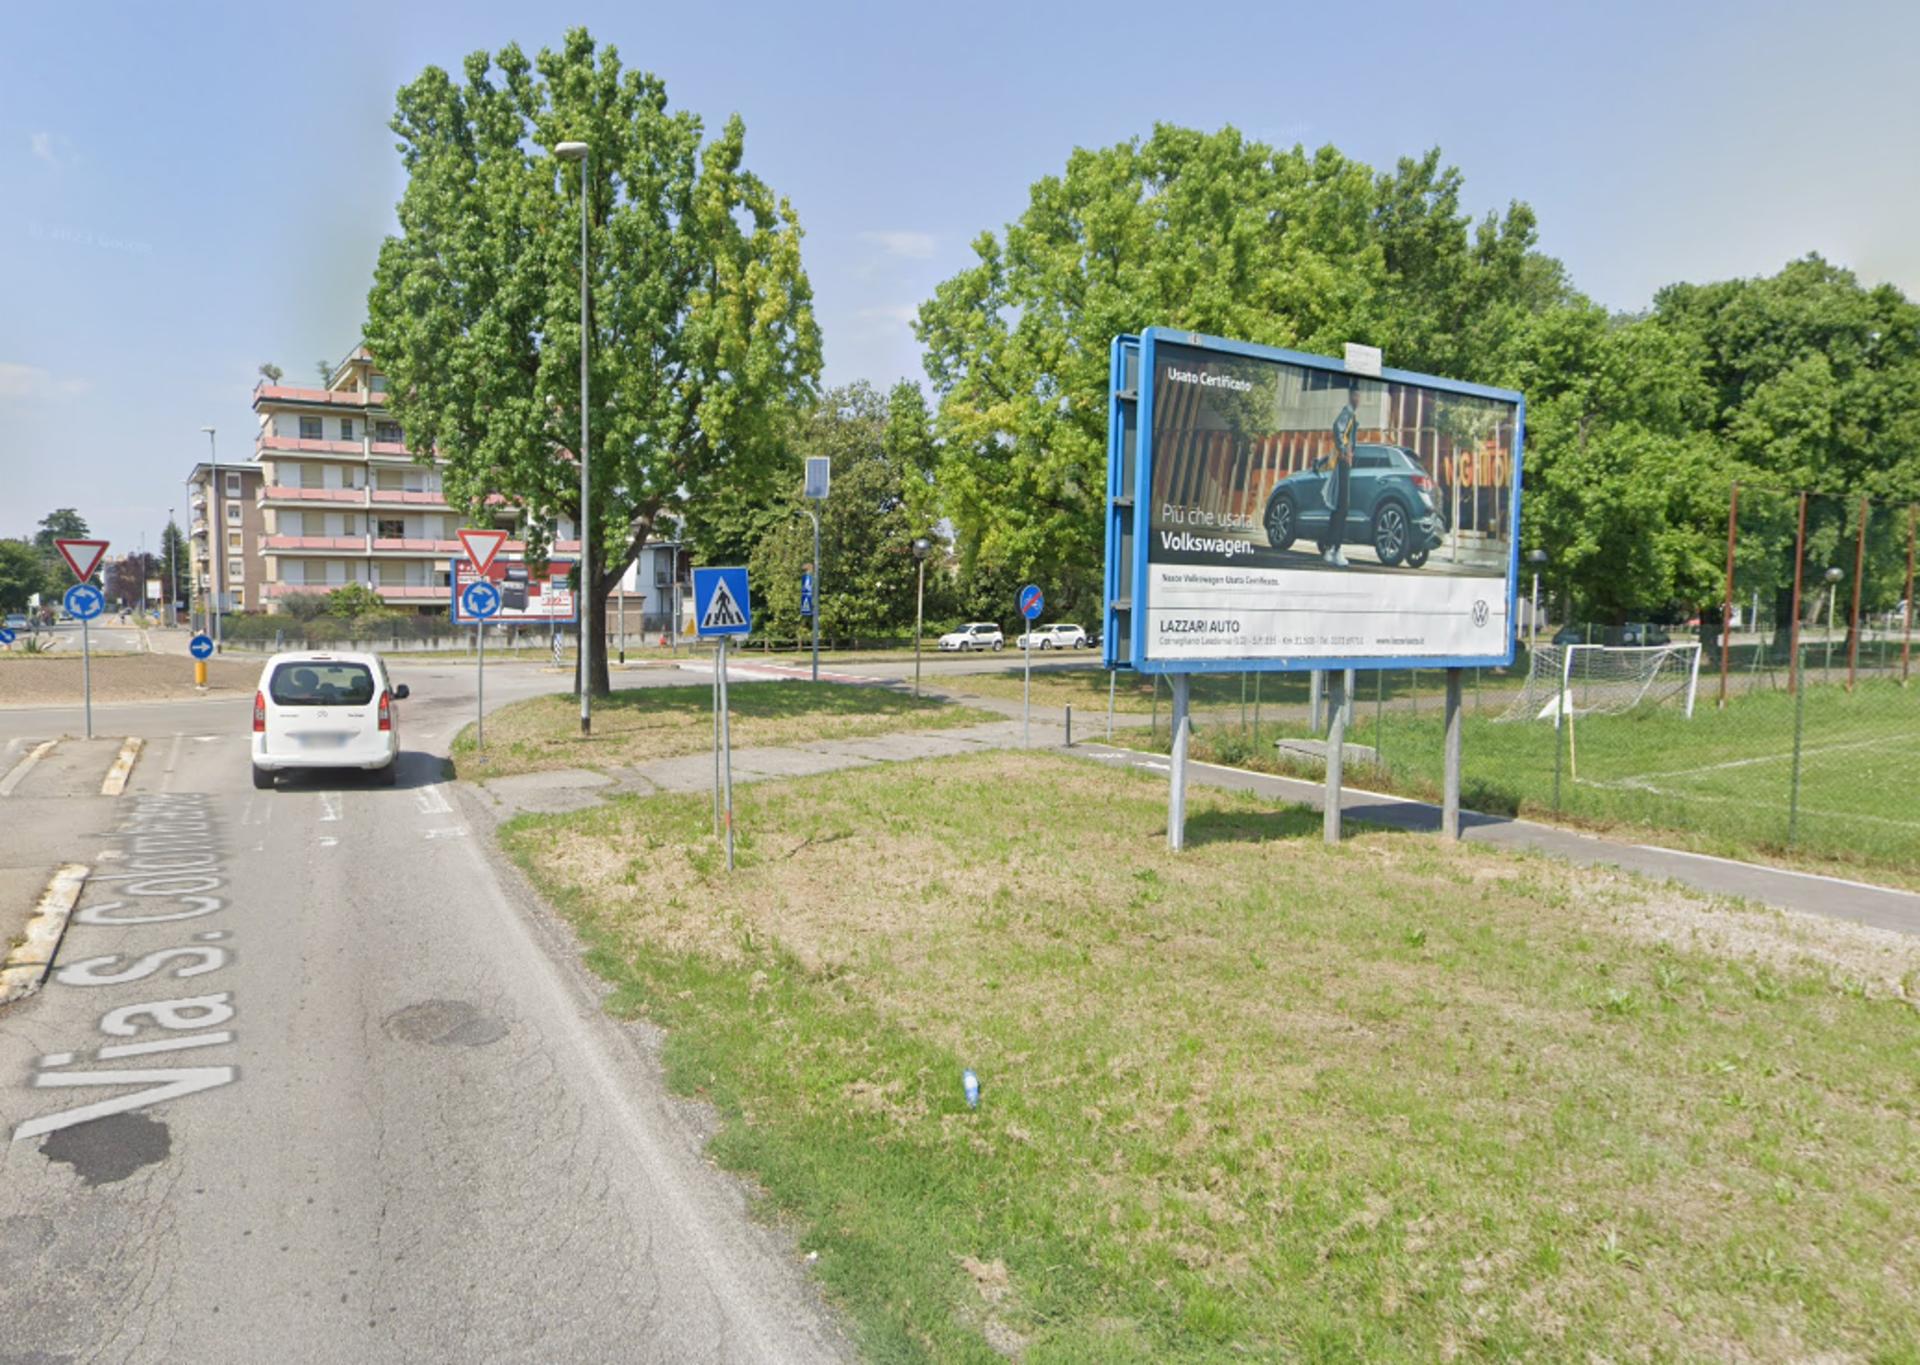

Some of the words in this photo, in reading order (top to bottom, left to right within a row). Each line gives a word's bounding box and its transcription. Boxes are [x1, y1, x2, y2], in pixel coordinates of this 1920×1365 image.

[1167, 366, 1198, 384] Usato
[1199, 371, 1252, 392] Certificato
[1188, 506, 1214, 526] che
[1161, 531, 1255, 557] Volkswagen.
[1159, 620, 1208, 633] LAZZARI
[1209, 620, 1240, 633] AUTO
